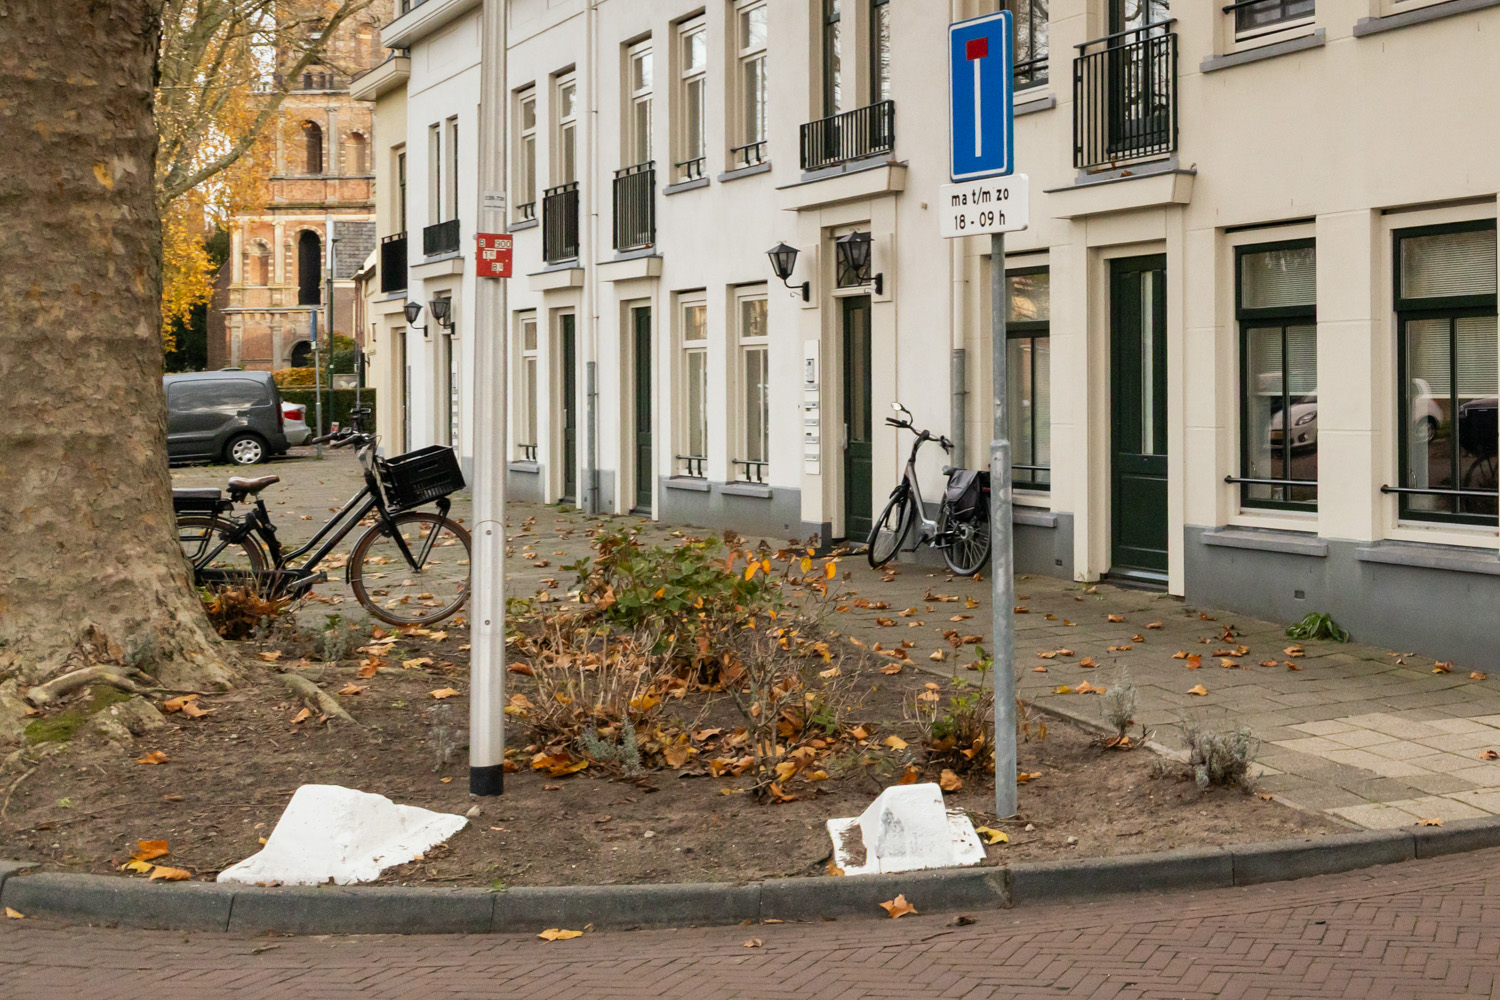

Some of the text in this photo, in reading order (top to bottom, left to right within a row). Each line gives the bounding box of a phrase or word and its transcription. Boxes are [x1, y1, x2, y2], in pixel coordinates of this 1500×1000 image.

[952, 186, 1009, 206] ma t/m zo
[954, 214, 966, 230] 18
[979, 210, 994, 227] 09
[999, 209, 1006, 225] h
[495, 240, 511, 248] 900
